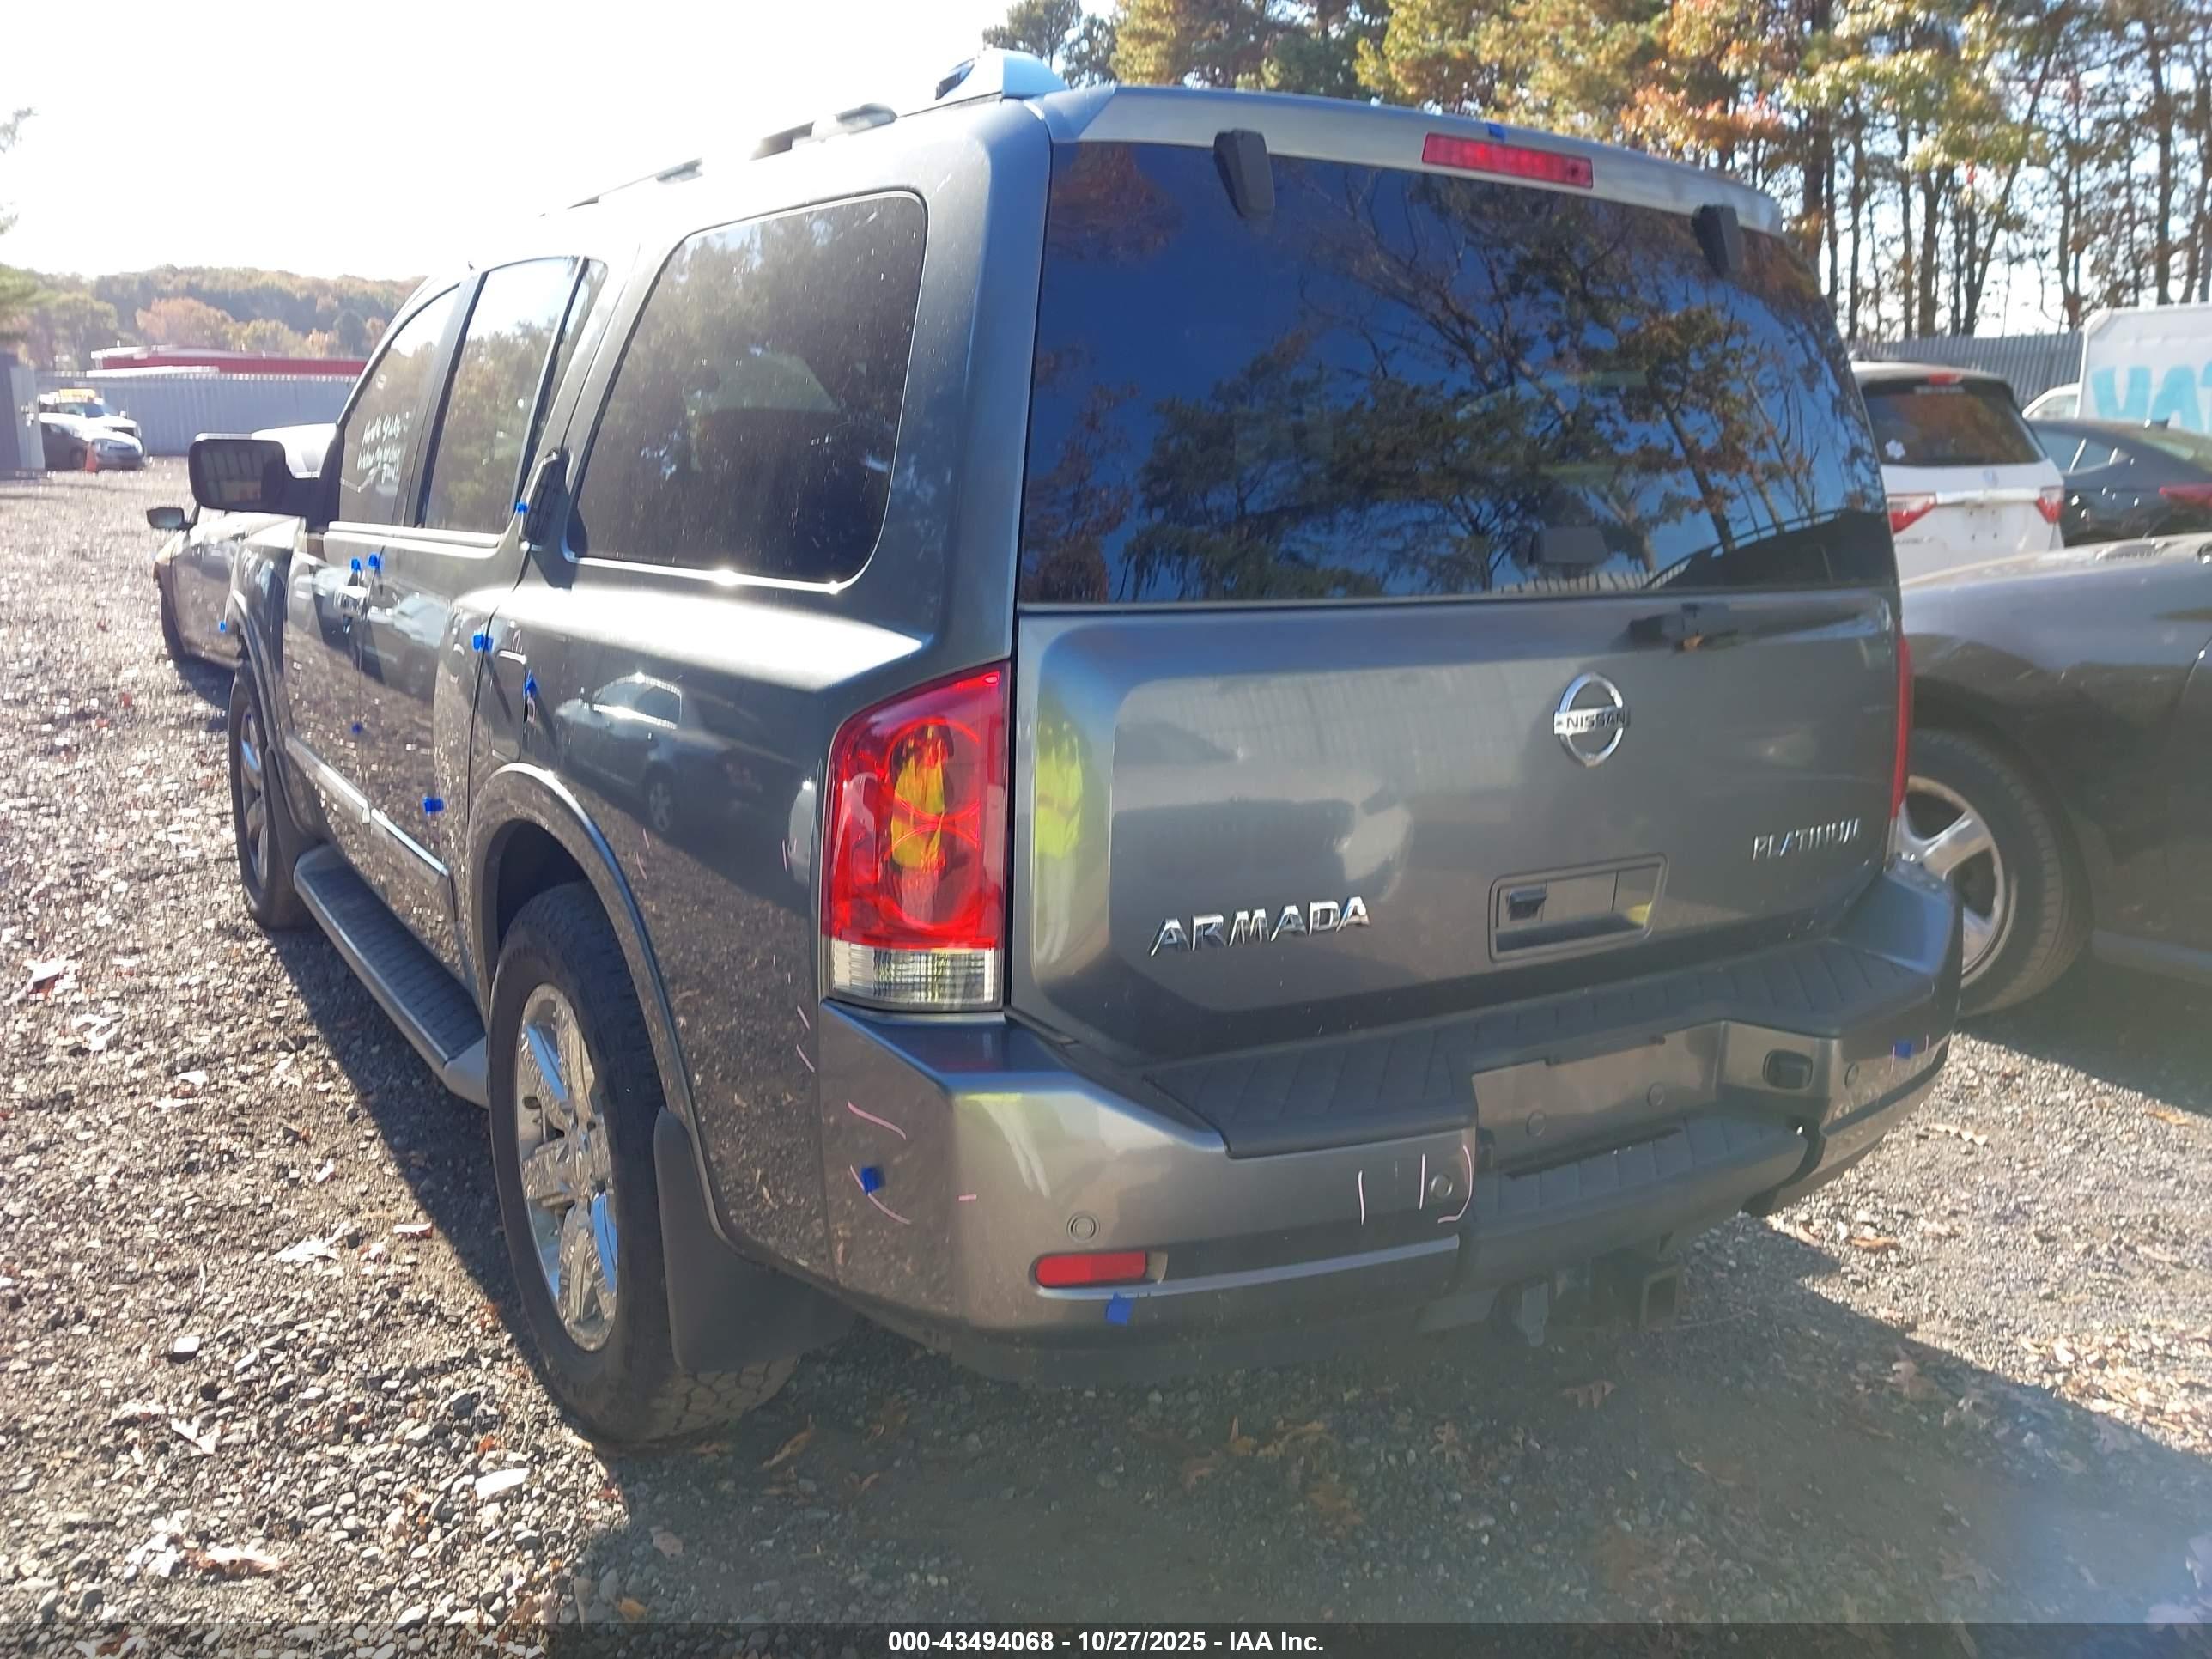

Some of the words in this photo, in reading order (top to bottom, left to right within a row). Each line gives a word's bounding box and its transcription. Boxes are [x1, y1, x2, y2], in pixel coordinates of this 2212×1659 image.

[1565, 709, 1628, 730] NISSAN
[1753, 818, 1860, 861] PLATINUM
[1147, 896, 1370, 957] ARMADA
